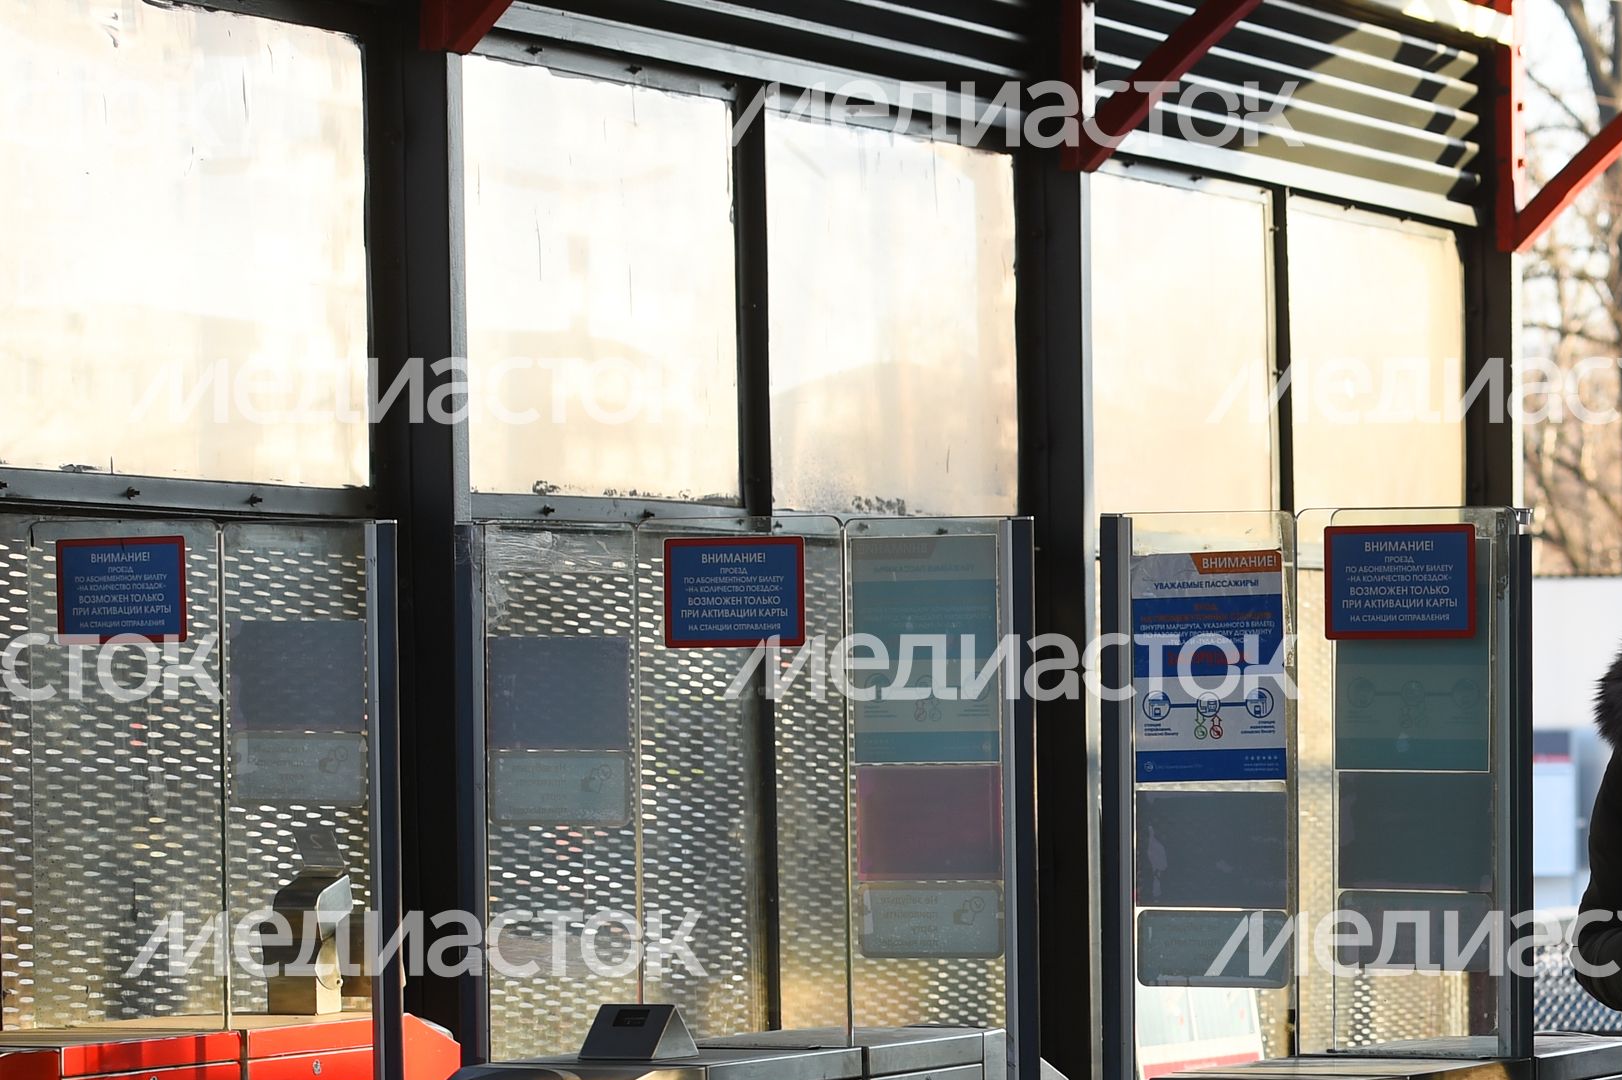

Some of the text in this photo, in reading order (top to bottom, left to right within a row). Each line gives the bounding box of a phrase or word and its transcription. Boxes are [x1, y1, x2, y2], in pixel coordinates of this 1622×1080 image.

[1365, 541, 1434, 552] ВНИМАНИЕ!
[90, 552, 150, 563] ВНИМАНИЕ!
[702, 553, 765, 563] ВНИМАНИЕ!
[1202, 556, 1276, 569] ВНИМАНИЕ!
[1154, 582, 1204, 590] УВАЖАЕМЫЕ
[1350, 586, 1449, 596] ВОЗМОЖЕН ТОЛЬКО
[79, 593, 164, 604] ВОЗМОЖЕН ТОЛЬКО
[688, 596, 780, 606] ВОЗМОЖЕН ТОЛЬКО
[1342, 598, 1458, 609] ПРИ АКТИВАЦИИ КАРТЫ
[73, 605, 171, 616] ПРИ АКТИВАЦИИ КАРТЫ
[681, 610, 699, 618] ПРИ
[701, 609, 756, 618] АКТИВАЦИИ
